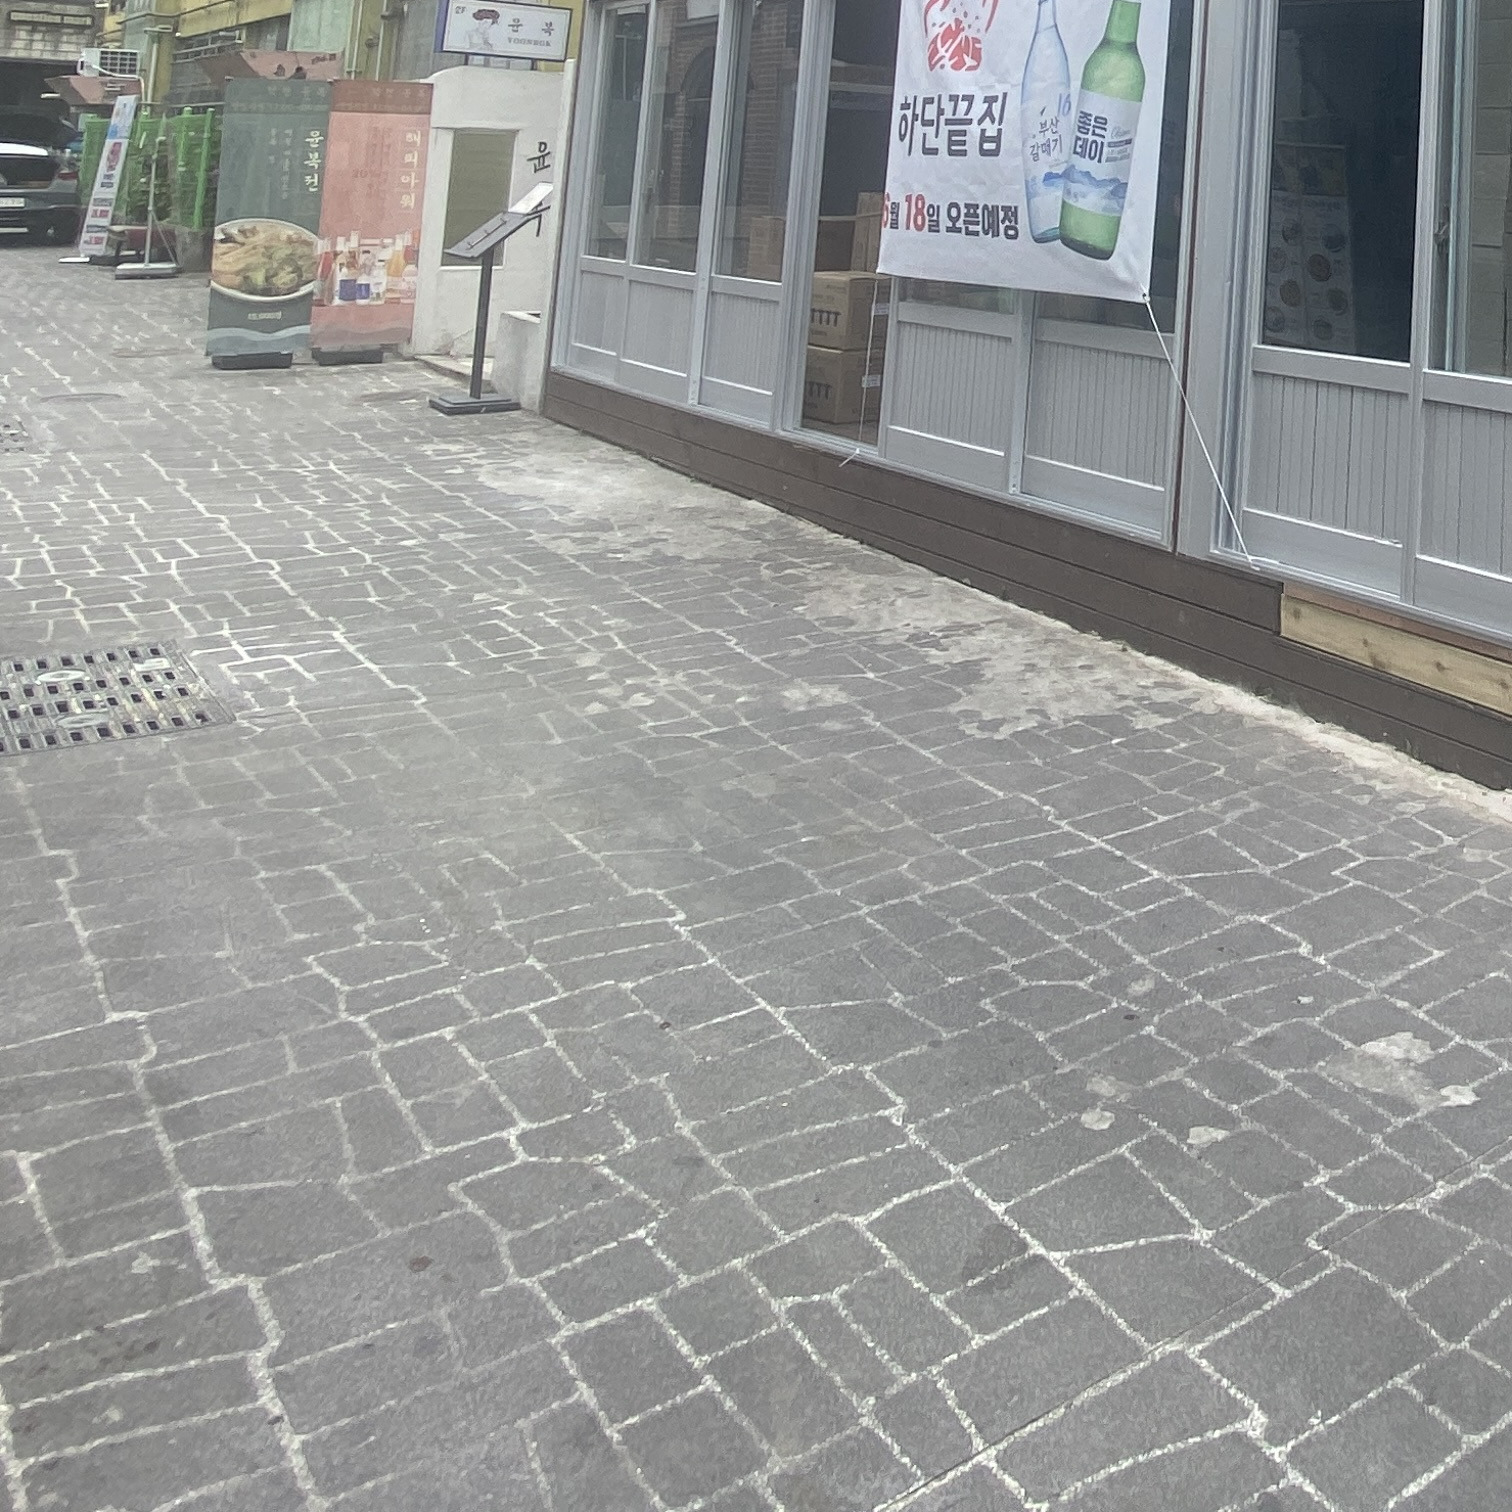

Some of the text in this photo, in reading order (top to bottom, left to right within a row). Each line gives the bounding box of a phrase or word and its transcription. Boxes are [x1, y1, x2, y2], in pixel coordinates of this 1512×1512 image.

[898, 91, 1009, 157] 하단끝집
[1038, 116, 1060, 138] 부산
[1077, 109, 1108, 140] 좋은
[1029, 133, 1063, 163] 갈매기
[1072, 134, 1105, 164] 데이
[881, 192, 1020, 240] 6월 18일 오픈예정
